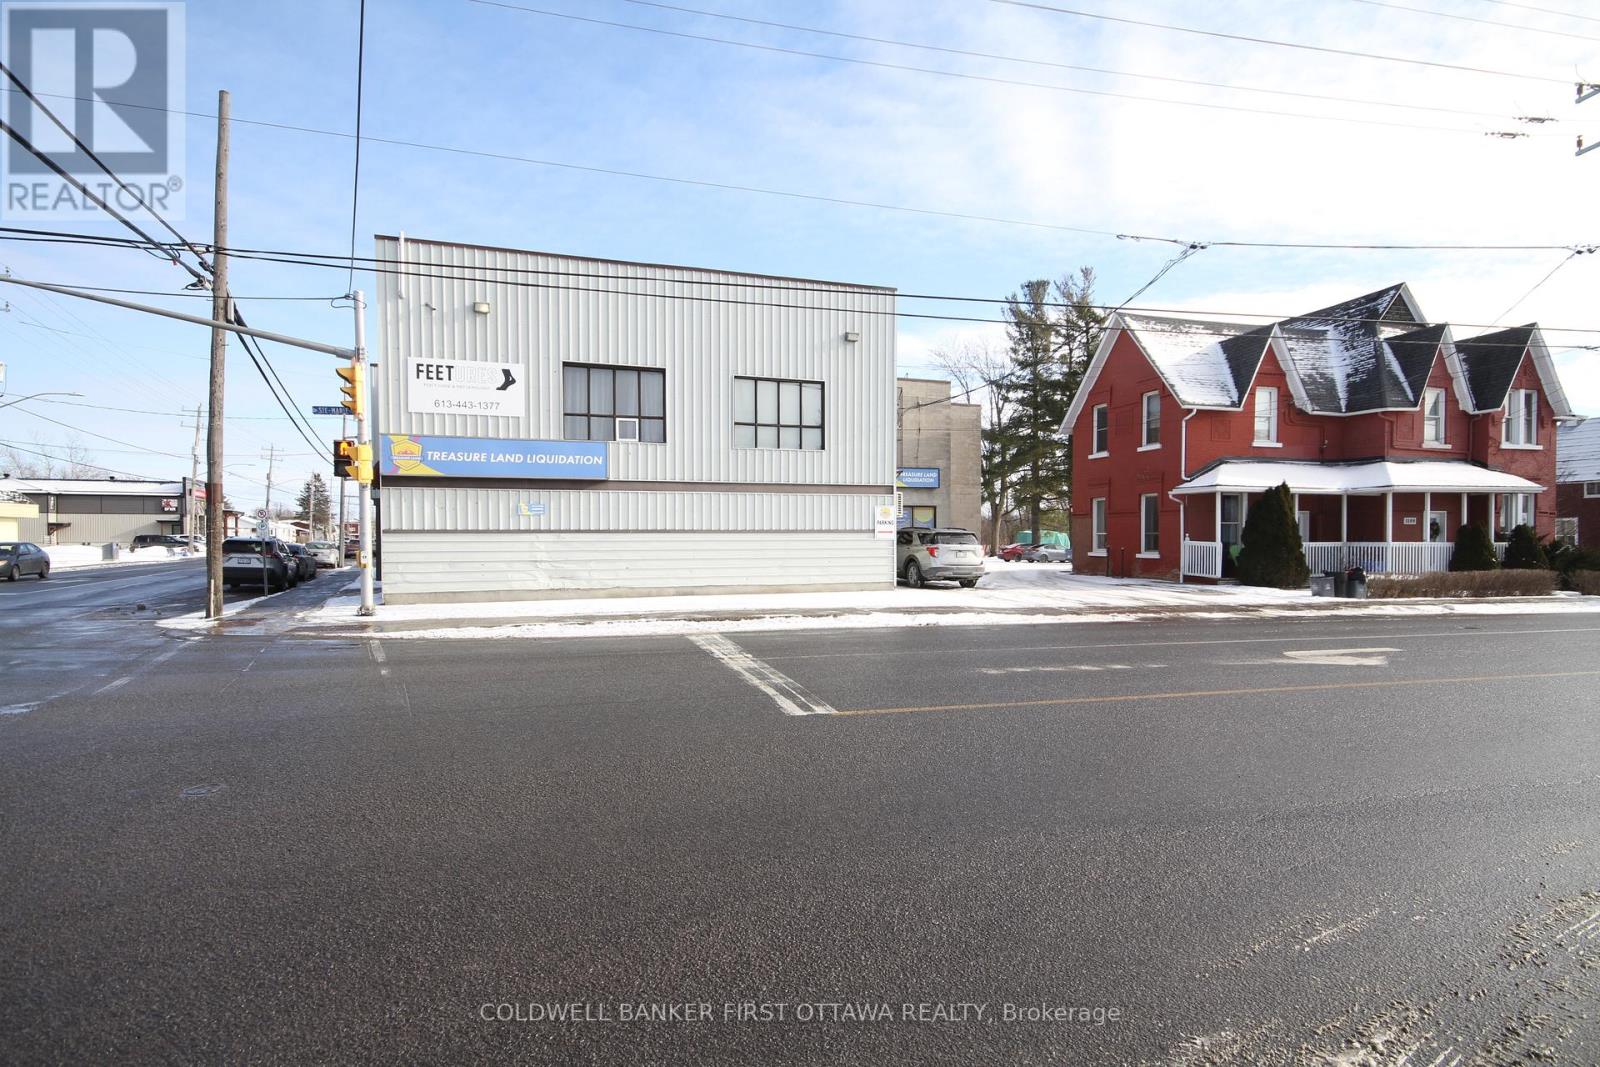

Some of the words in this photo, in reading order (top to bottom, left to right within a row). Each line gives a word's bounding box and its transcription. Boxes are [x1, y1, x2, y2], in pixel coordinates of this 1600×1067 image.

[434, 399, 500, 410] 613-443-1377
[427, 451, 487, 462] TREASURE
[490, 453, 523, 464] LAND
[527, 454, 603, 465] LIQUIDATION
